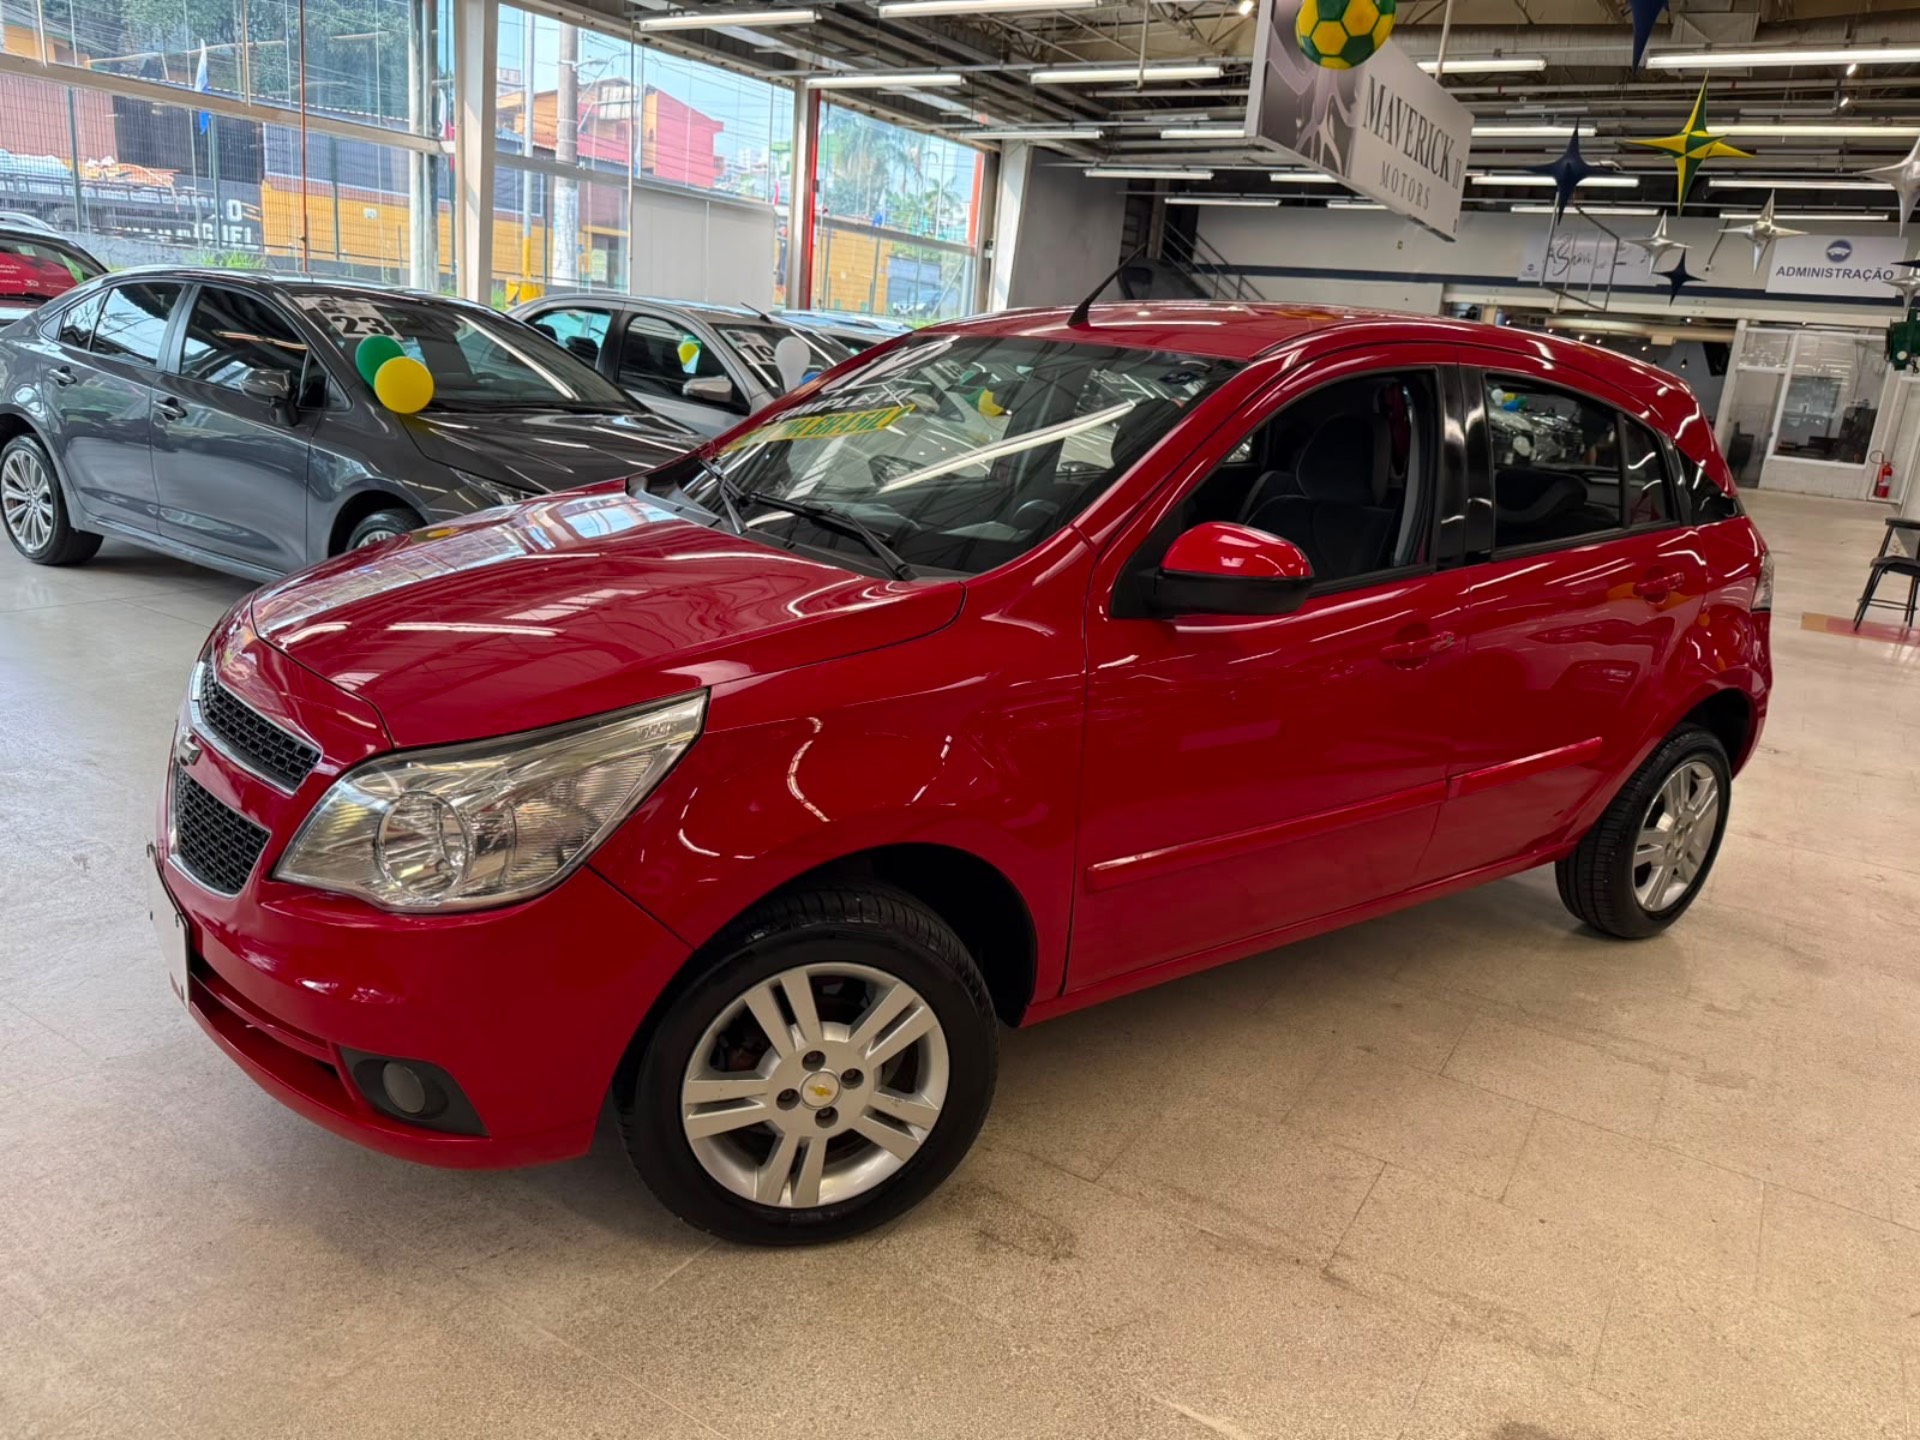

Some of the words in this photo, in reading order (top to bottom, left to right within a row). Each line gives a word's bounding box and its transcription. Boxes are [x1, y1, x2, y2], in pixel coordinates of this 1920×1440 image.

[1362, 75, 1455, 183] MAVERICK
[1379, 161, 1431, 211] MOTORS
[1776, 265, 1895, 282] ADMINISTRAÇÃO
[331, 316, 394, 335] 23
[763, 388, 914, 426] COMPLETO
